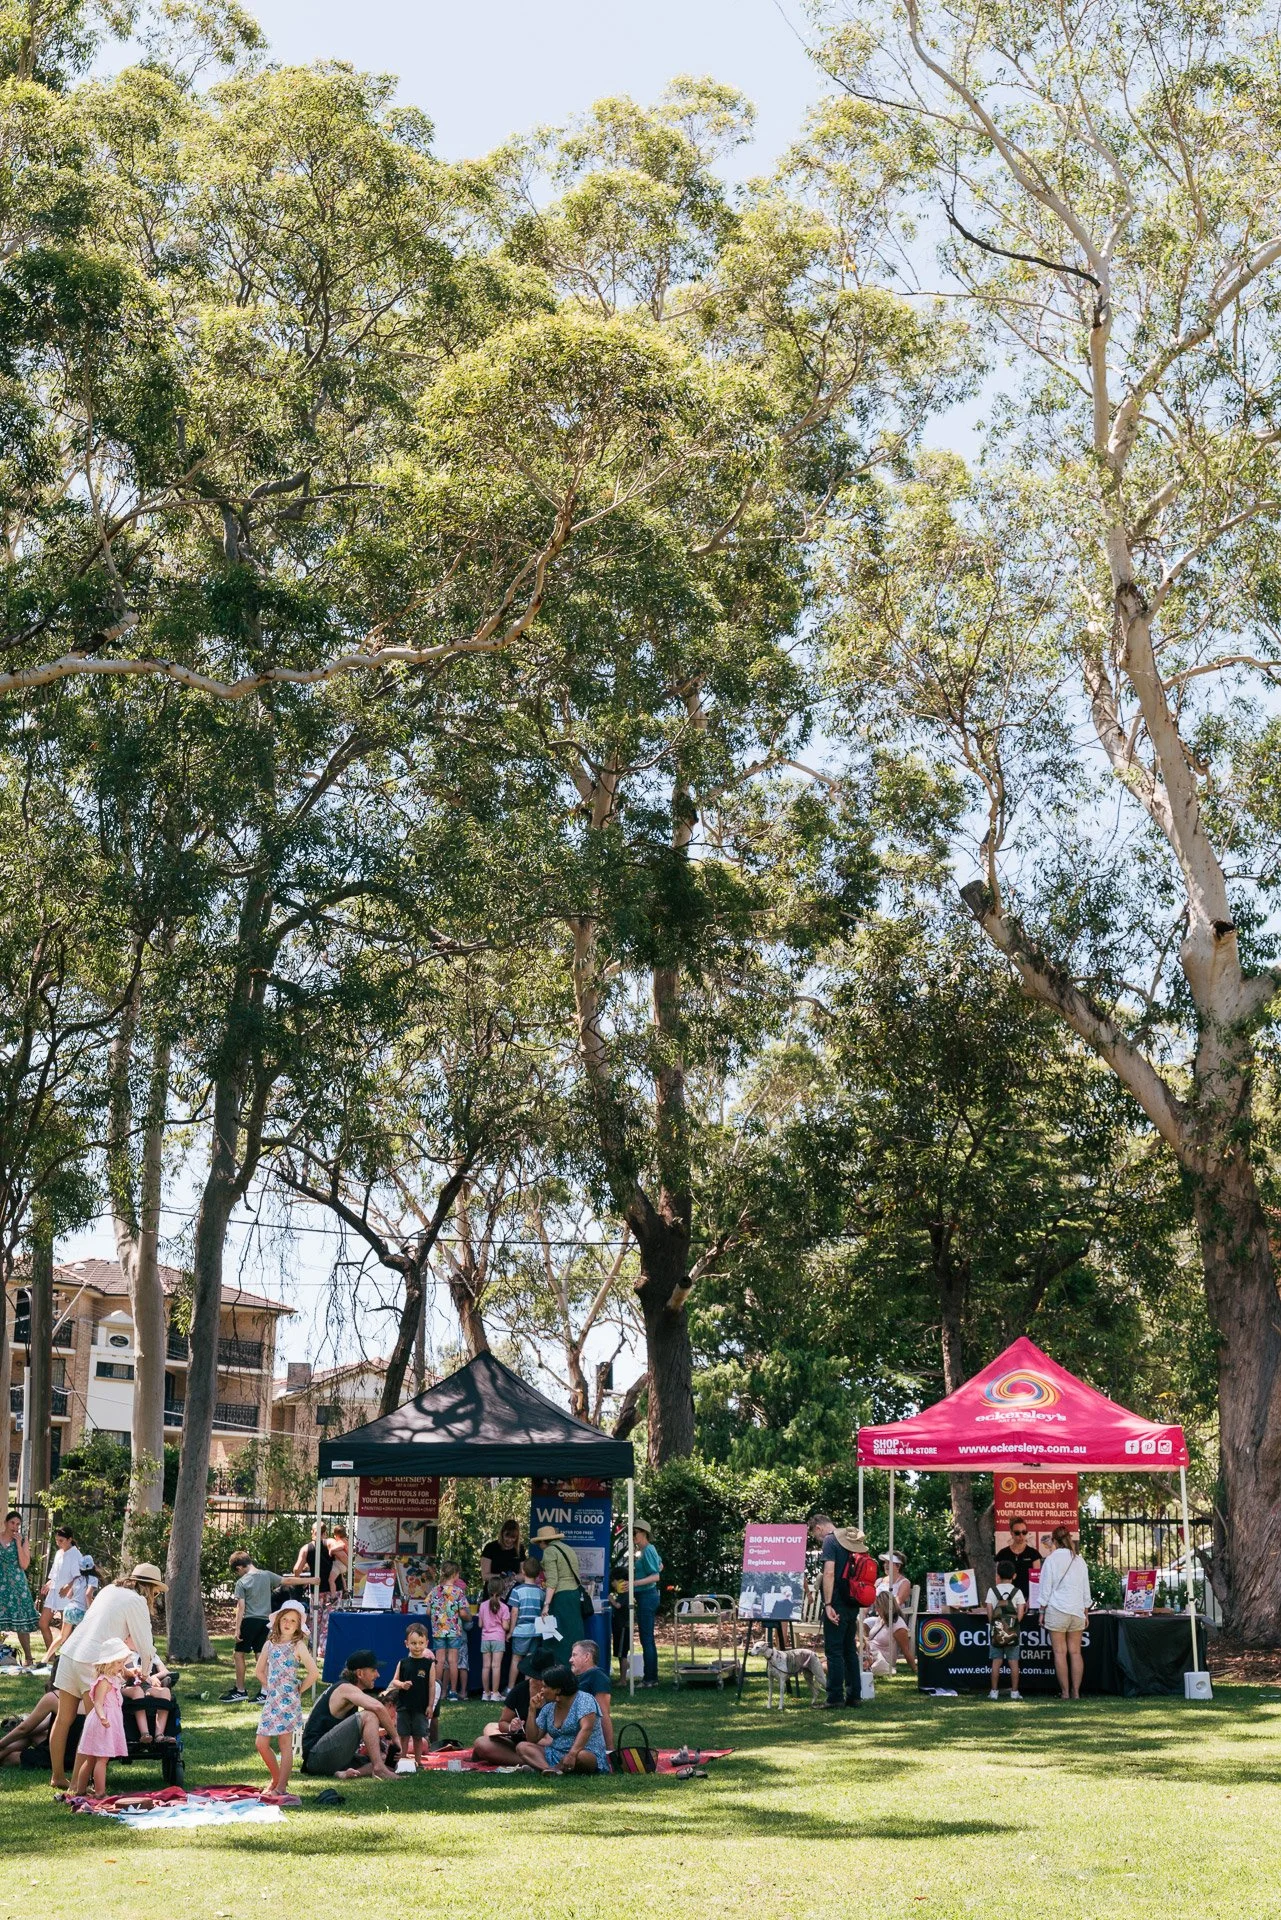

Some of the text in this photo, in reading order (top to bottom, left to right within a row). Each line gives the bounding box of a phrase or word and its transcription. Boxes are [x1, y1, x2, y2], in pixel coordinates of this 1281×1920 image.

[975, 1410, 1067, 1422] eckersley's
[873, 1439, 900, 1448] SHOP
[958, 1442, 1086, 1454] www.eckersleys.com.au
[1018, 1479, 1074, 1493] eckersley's
[558, 1490, 586, 1498] Creative
[536, 1508, 572, 1523] WIN
[1020, 1650, 1052, 1660] CRAFT
